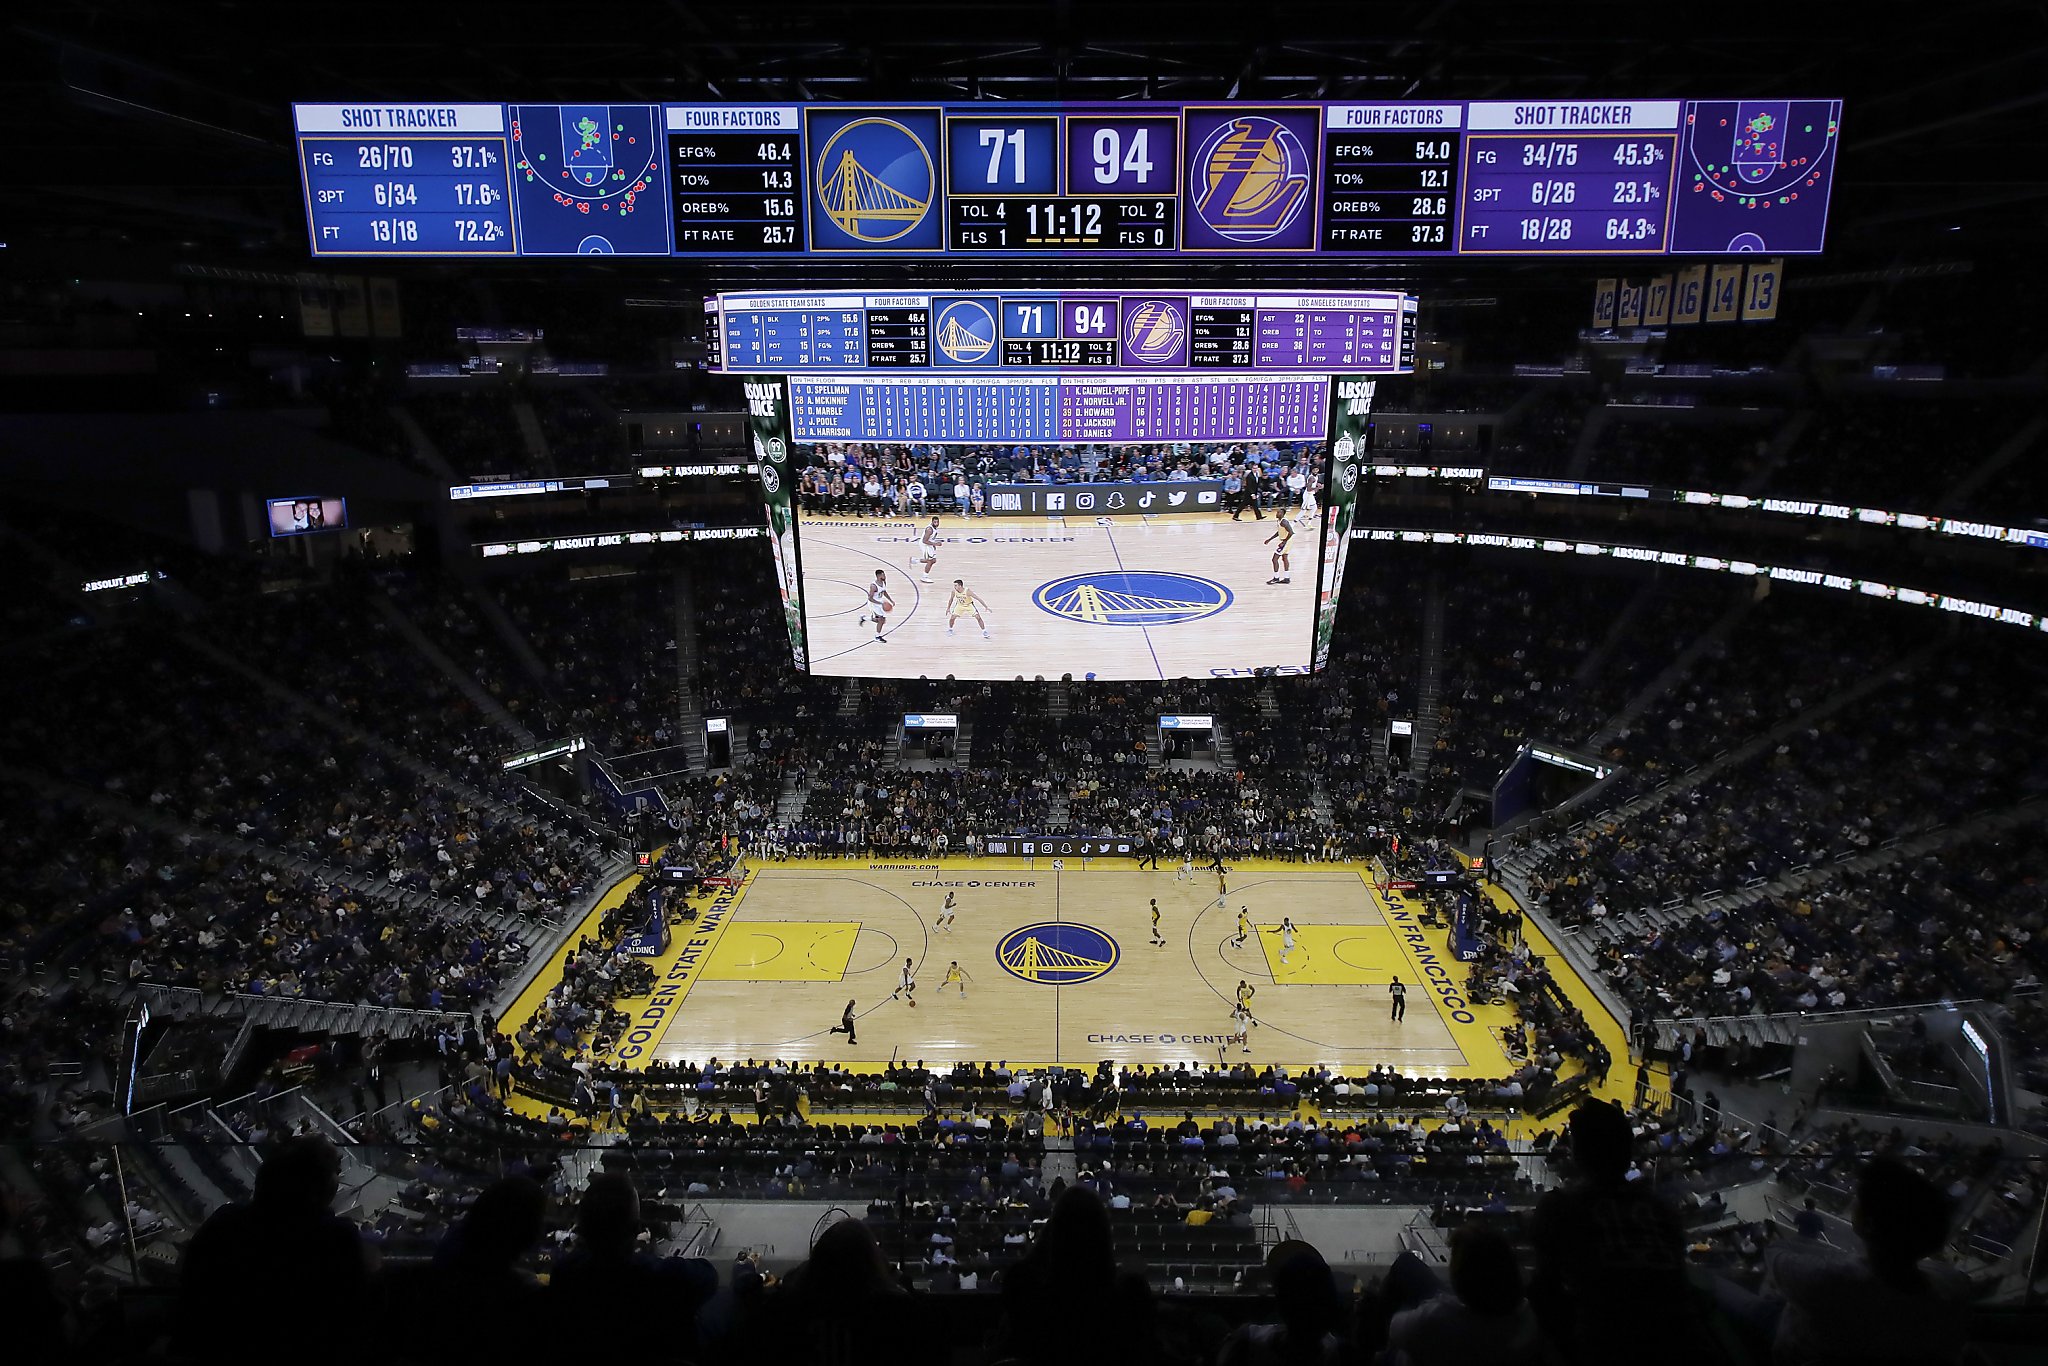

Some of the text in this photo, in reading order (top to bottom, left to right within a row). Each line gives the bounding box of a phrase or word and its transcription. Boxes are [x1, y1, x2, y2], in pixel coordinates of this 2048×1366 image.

[342, 109, 456, 127] SHOT TRACKER
[686, 111, 780, 126] FOUR FACTORS
[1347, 110, 1442, 124] FOUR FACTORS
[1515, 106, 1631, 124] SHOT TRACKER
[314, 145, 496, 170] FG 26/70 37.1%
[679, 143, 791, 160] EFG% 46.4
[980, 130, 1024, 183] 71
[1094, 129, 1153, 183] 94
[1336, 142, 1449, 159] EFG% 54.0
[1477, 142, 1663, 168] FG 34/75 45.3%
[681, 172, 791, 188] TO% 14.3
[1335, 170, 1447, 186] TO% 12.1
[318, 182, 500, 207] 3PT 6/34 17.6%
[1474, 180, 1659, 205] 3PT 6/26 23.1%
[683, 199, 793, 215] OREB% 15.6
[961, 203, 1005, 218] TOL 4
[1120, 202, 1164, 218] TOL 2
[1333, 198, 1446, 214] OREB% 28.6
[1027, 204, 1101, 234] 11:12
[323, 219, 503, 243] FT 13/18 72.2%
[685, 227, 794, 243] FT RATE 25.7
[963, 229, 1005, 245] FLS 1
[1120, 229, 1163, 245] FLS 0
[1332, 226, 1443, 242] FT RATE 37.3
[1472, 218, 1655, 242] FT 18/28 64.3%
[1678, 282, 1697, 314] 16
[1713, 277, 1734, 312] 14
[1750, 272, 1774, 310] 13
[875, 298, 920, 306] FOUR FACTORS
[1621, 286, 1640, 318] 24
[1650, 286, 1664, 316] 17
[908, 314, 925, 322] 46.4
[1018, 307, 1041, 333] 71
[1075, 306, 1106, 333] 94
[1241, 314, 1250, 322] 54
[910, 327, 925, 336] 14.3
[1236, 328, 1249, 336] 12.1
[911, 341, 925, 349] 15.6
[1026, 342, 1031, 351] 4
[1042, 343, 1080, 358] 11:12
[1107, 342, 1111, 351] 2
[1233, 341, 1249, 349] 28.6
[910, 354, 925, 363] 25.7
[1028, 356, 1031, 364] 1
[1107, 356, 1111, 364] 0
[1233, 355, 1248, 363] 37.3
[815, 386, 849, 394] SPELLMAN
[1338, 381, 1376, 398] ABSOLU
[817, 428, 850, 436] HARRISON
[772, 442, 780, 451] 99
[675, 466, 739, 476] ABSOLUT JUICE
[1440, 468, 1483, 478] ABSOLUT
[992, 494, 1021, 511] @NBA
[1762, 500, 1850, 518] ABSOLUT JUICE
[801, 520, 915, 528] WARRIORS.COM
[1942, 520, 2005, 539] ABSOLUT
[694, 528, 758, 540] ABSOLUT JUICE
[1371, 531, 1394, 540] JUICE
[1467, 534, 1535, 549] ABSOLUT JUICE
[554, 535, 621, 550] ABSOLUT JUICE
[1612, 547, 1686, 566] ABSOLUT JUICE
[85, 574, 147, 592] ABSOLUT JUICE
[1770, 567, 1852, 590] ABSOLUT JUICE
[1940, 596, 2031, 627] ABSOLUT JUICE
[988, 841, 1007, 854] @NBA
[1382, 896, 1475, 1024] SAN FRANCISCO
[618, 984, 682, 1059] GOLDEN
[667, 938, 709, 980] STATE
[1087, 1034, 1154, 1042] CHASE
